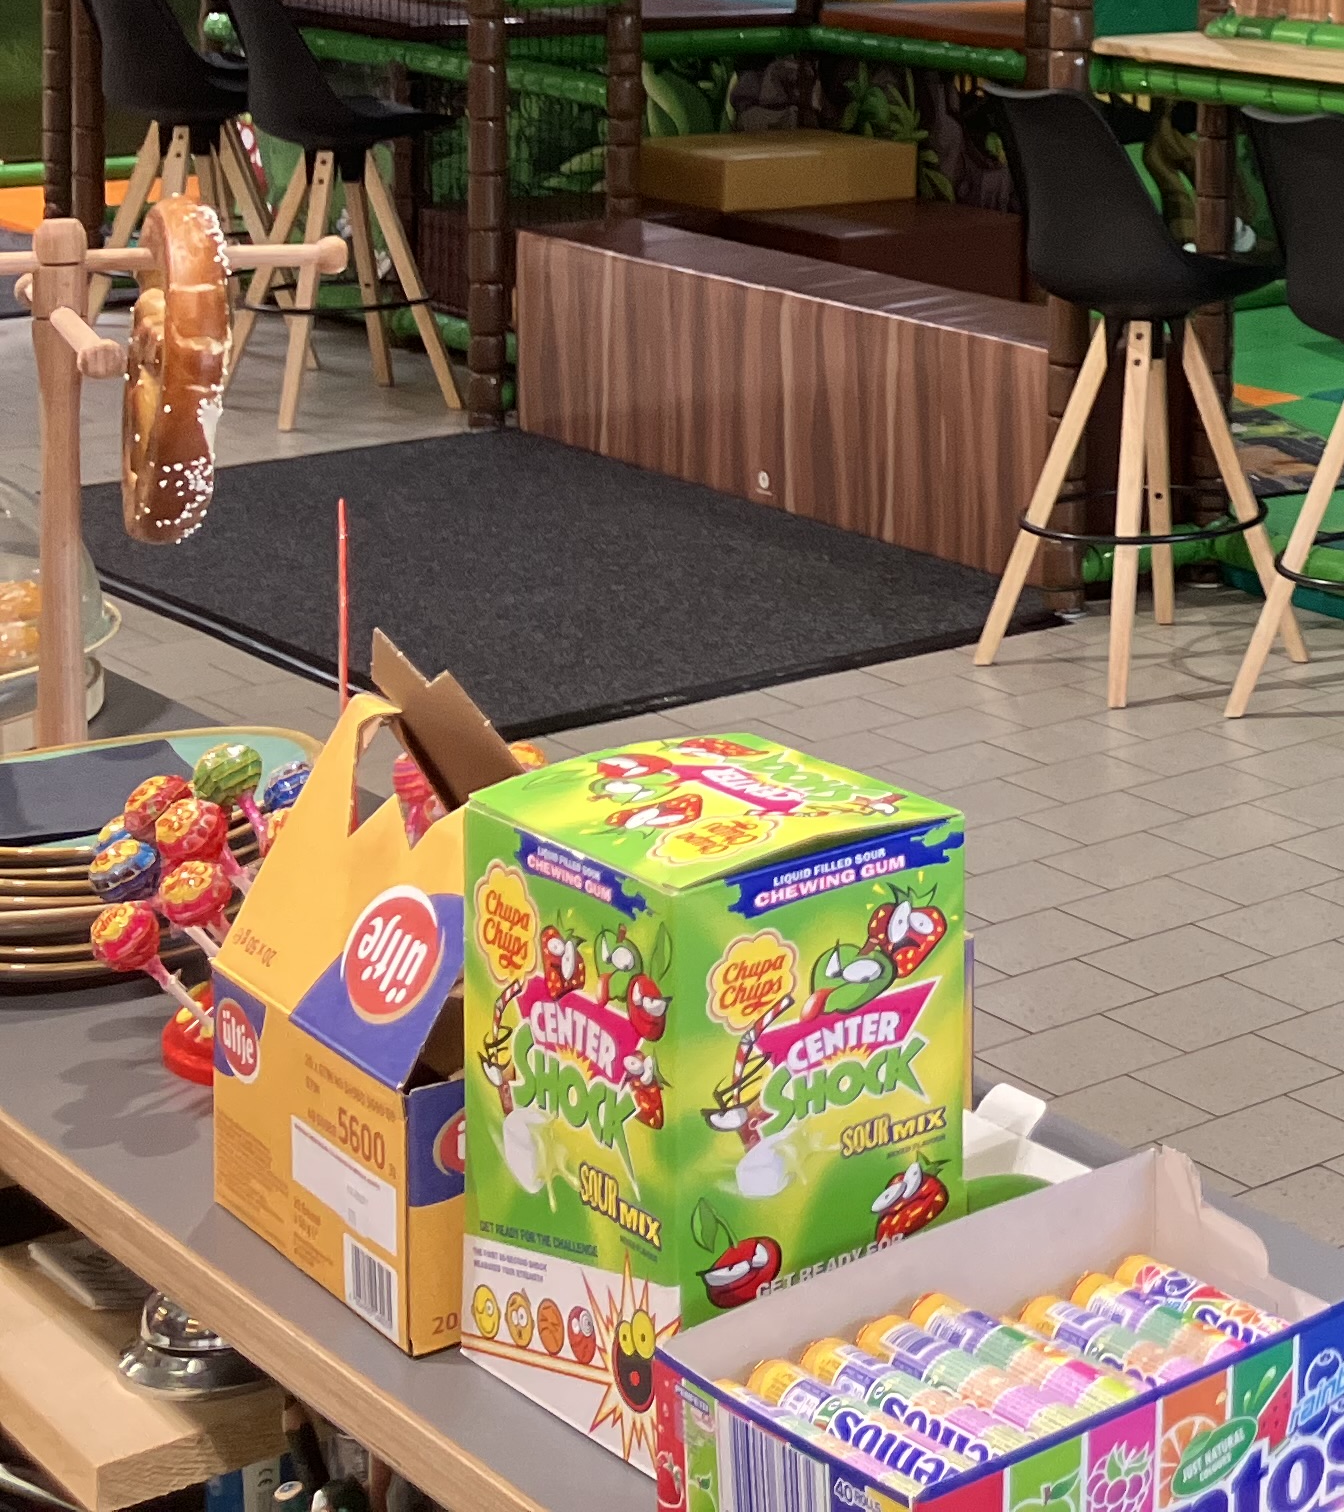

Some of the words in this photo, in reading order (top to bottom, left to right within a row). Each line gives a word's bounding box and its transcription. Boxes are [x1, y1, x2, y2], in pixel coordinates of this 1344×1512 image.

[527, 854, 583, 889] CHEWING
[584, 880, 613, 904] GUM
[754, 868, 856, 908] CHEWING
[860, 854, 906, 878] GUM
[773, 868, 811, 887] LIQUID
[813, 857, 853, 878] FILLED
[854, 847, 887, 865] SOUR
[486, 890, 531, 933] Chupa
[261, 949, 278, 968] 20
[357, 914, 429, 1004] ültje
[483, 918, 529, 962] Chups
[719, 975, 784, 1013] Chups
[722, 952, 786, 986] Chupa
[222, 1008, 255, 1066] ültje
[530, 1000, 616, 1079] CENTER
[786, 1010, 901, 1072] CENTER
[512, 1023, 638, 1168] SHOCK
[762, 1037, 928, 1138] SHOCK
[337, 1106, 386, 1171] 5600
[840, 1113, 890, 1159] SOUR
[889, 1105, 948, 1143] MIX
[579, 1161, 619, 1224] SOUR
[618, 1200, 663, 1251] MIX
[756, 1272, 798, 1299] GET
[799, 1246, 864, 1284] READY
[866, 1232, 905, 1255] FOR
[432, 1311, 459, 1335] 20
[1182, 1460, 1202, 1484] JUST
[1203, 1427, 1246, 1460] NATURAL
[833, 1477, 856, 1506] 40
[853, 1489, 882, 1512] ROLLS
